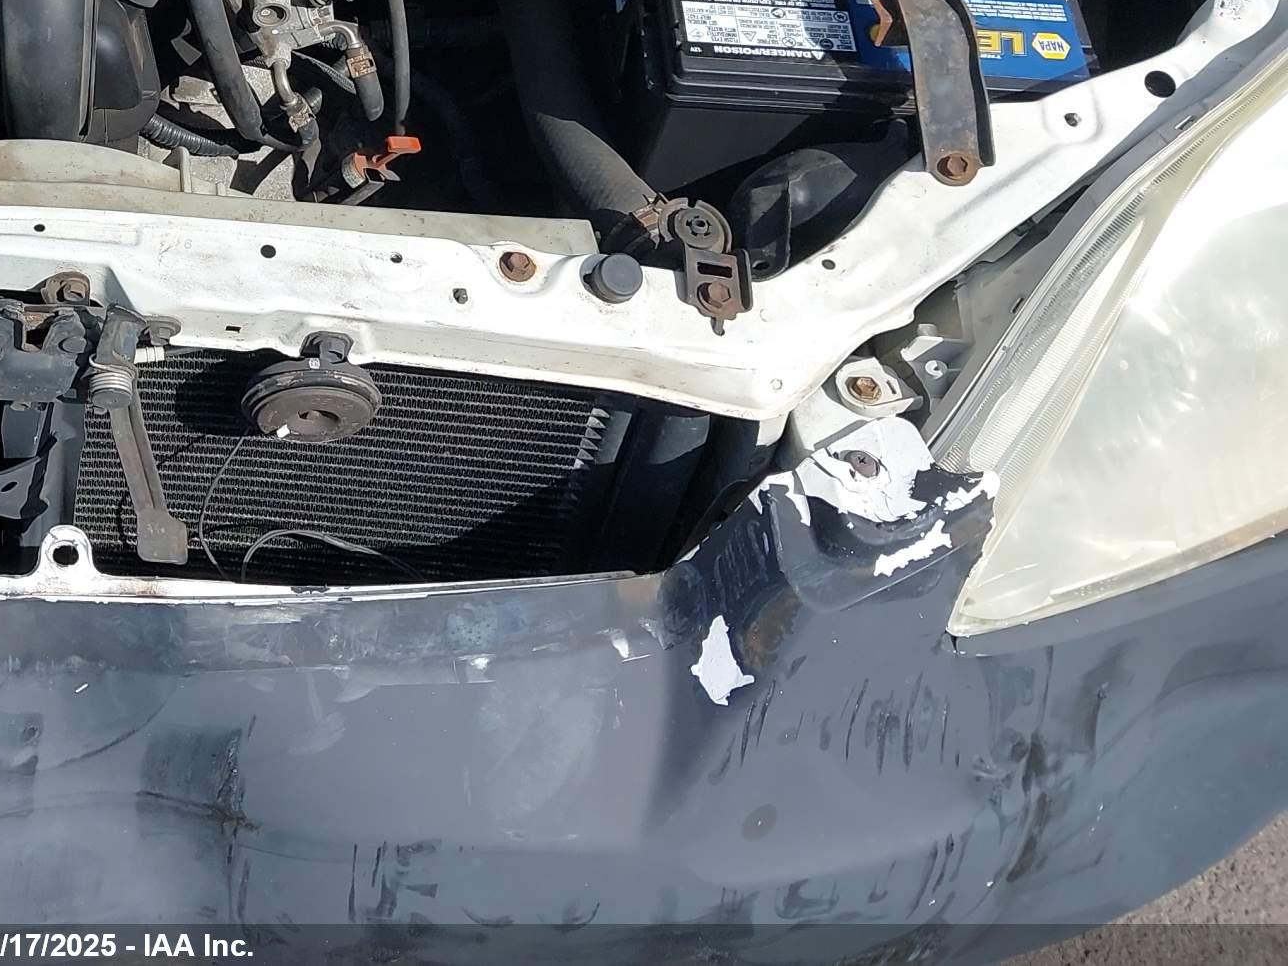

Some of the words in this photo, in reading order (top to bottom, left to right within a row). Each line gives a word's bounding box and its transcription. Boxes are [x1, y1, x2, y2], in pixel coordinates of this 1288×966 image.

[976, 29, 1026, 57] LE
[1038, 41, 1065, 53] NAPA
[713, 45, 812, 58] DANGER/POISON
